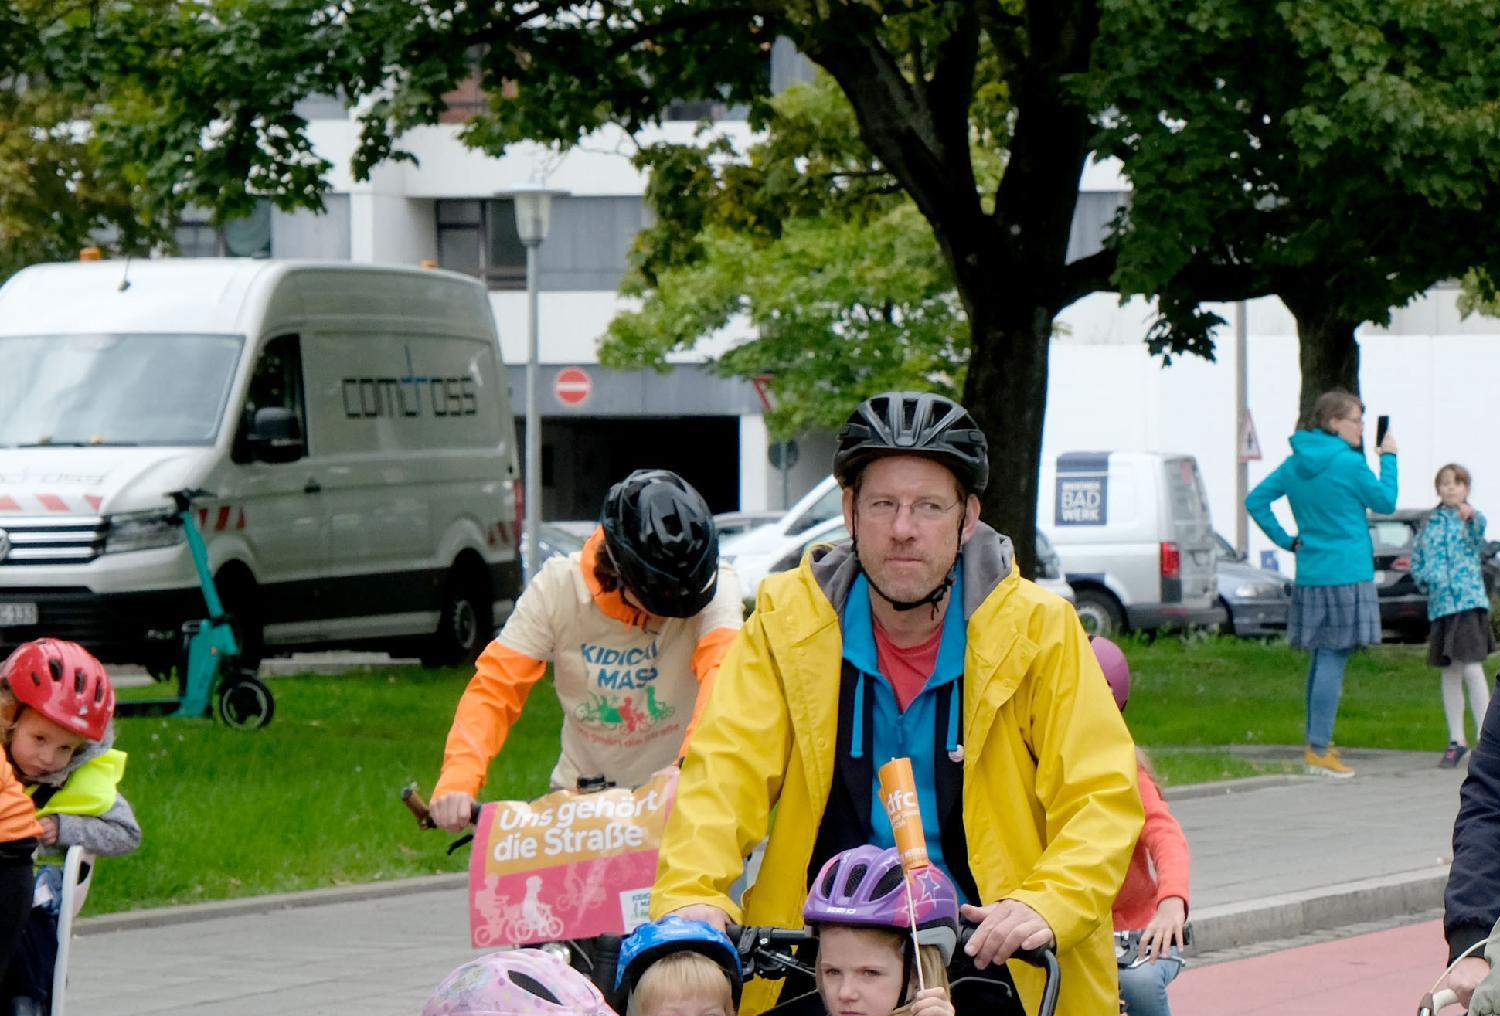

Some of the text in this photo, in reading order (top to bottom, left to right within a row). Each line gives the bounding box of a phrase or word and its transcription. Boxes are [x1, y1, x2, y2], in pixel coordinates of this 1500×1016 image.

[1062, 489, 1101, 508] BAD
[1062, 509, 1101, 521] WERK
[580, 640, 658, 666] KIDIC
[499, 790, 659, 831] Uns gehört
[493, 823, 643, 862] die Straße
